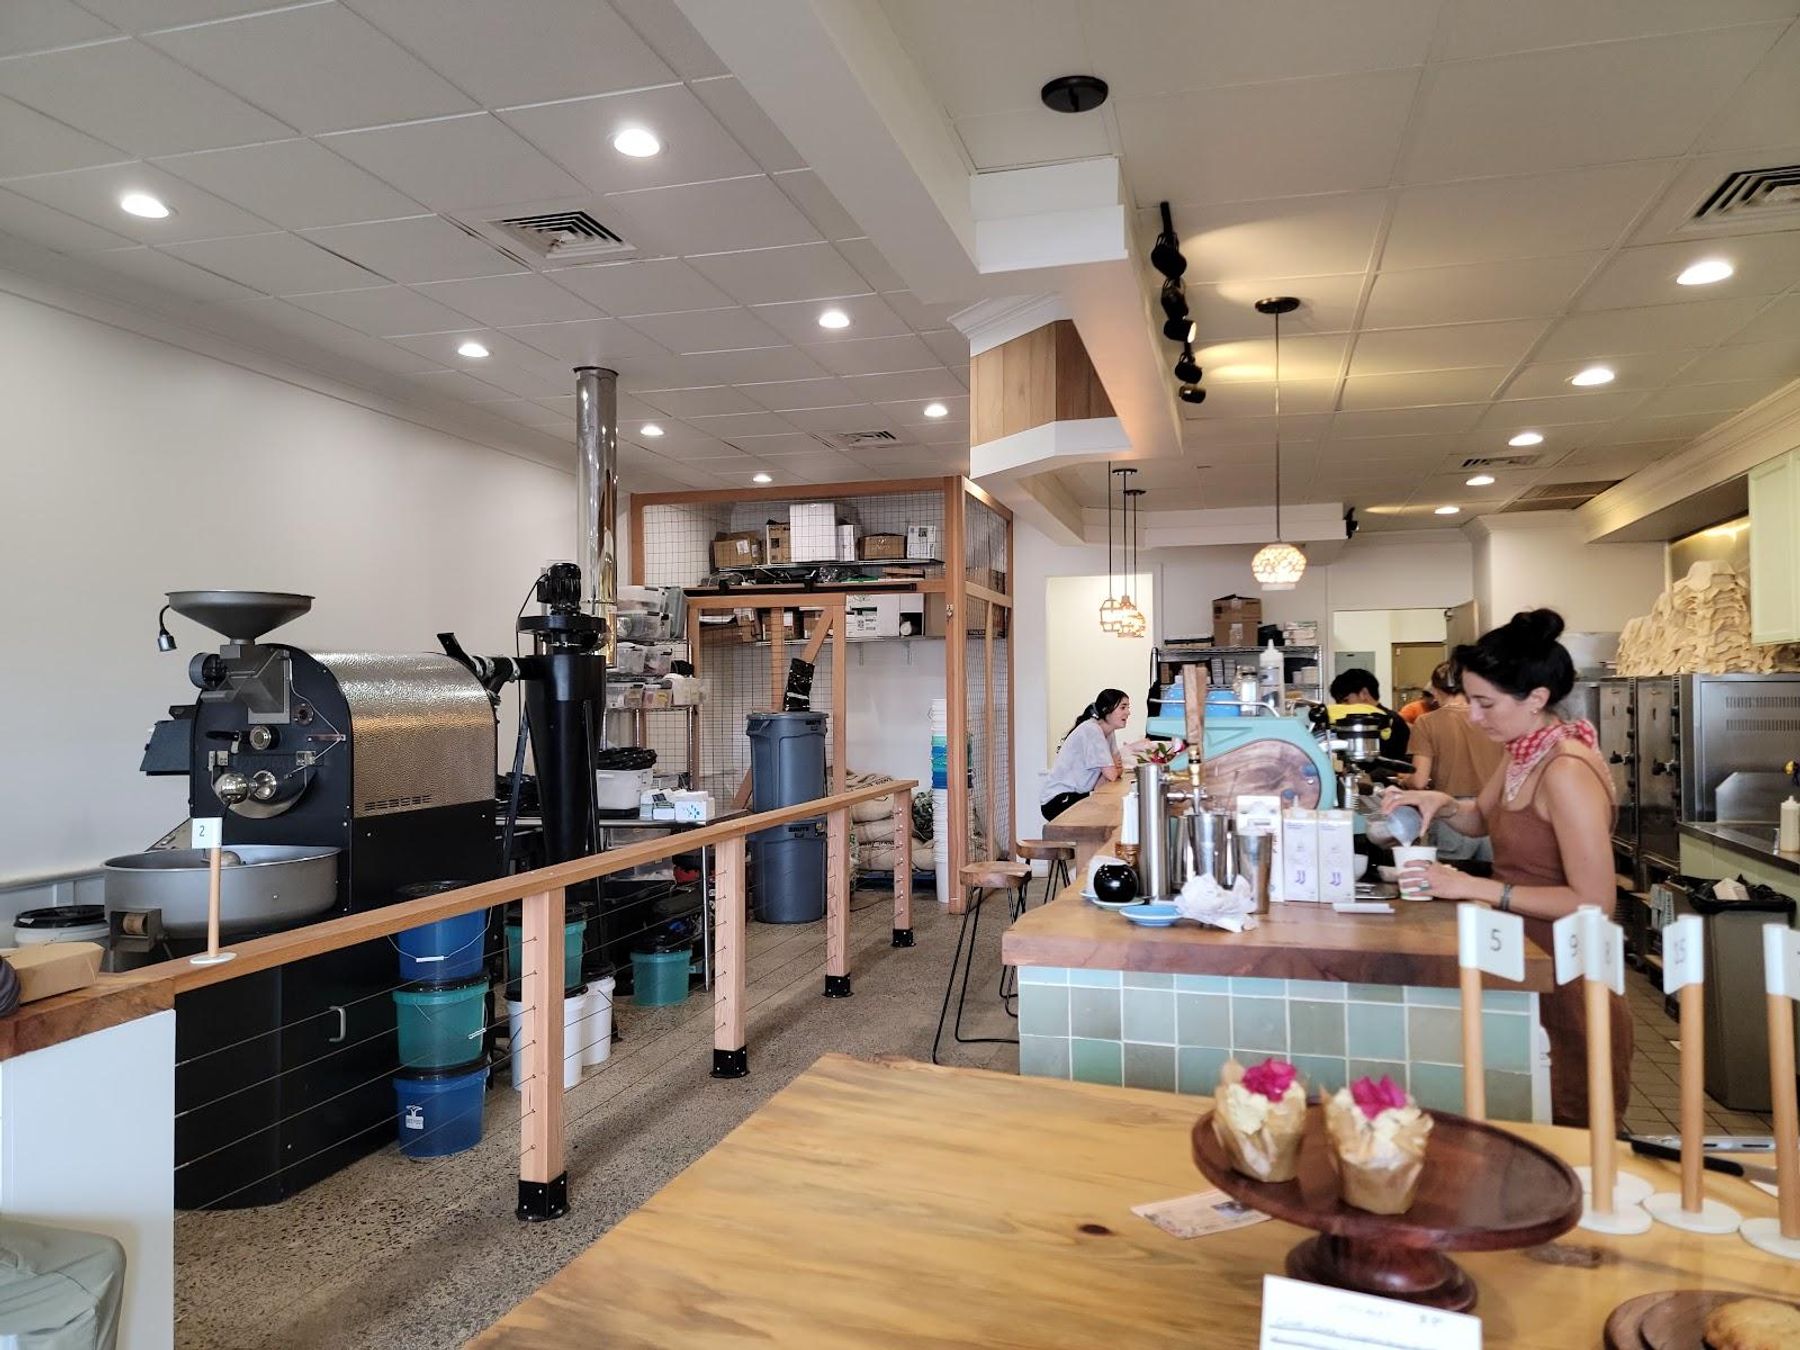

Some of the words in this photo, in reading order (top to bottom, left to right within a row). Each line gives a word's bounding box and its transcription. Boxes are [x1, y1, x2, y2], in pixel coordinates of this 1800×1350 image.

[199, 825, 205, 837] 2
[1490, 928, 1502, 951] 5
[1569, 934, 1579, 957] 9
